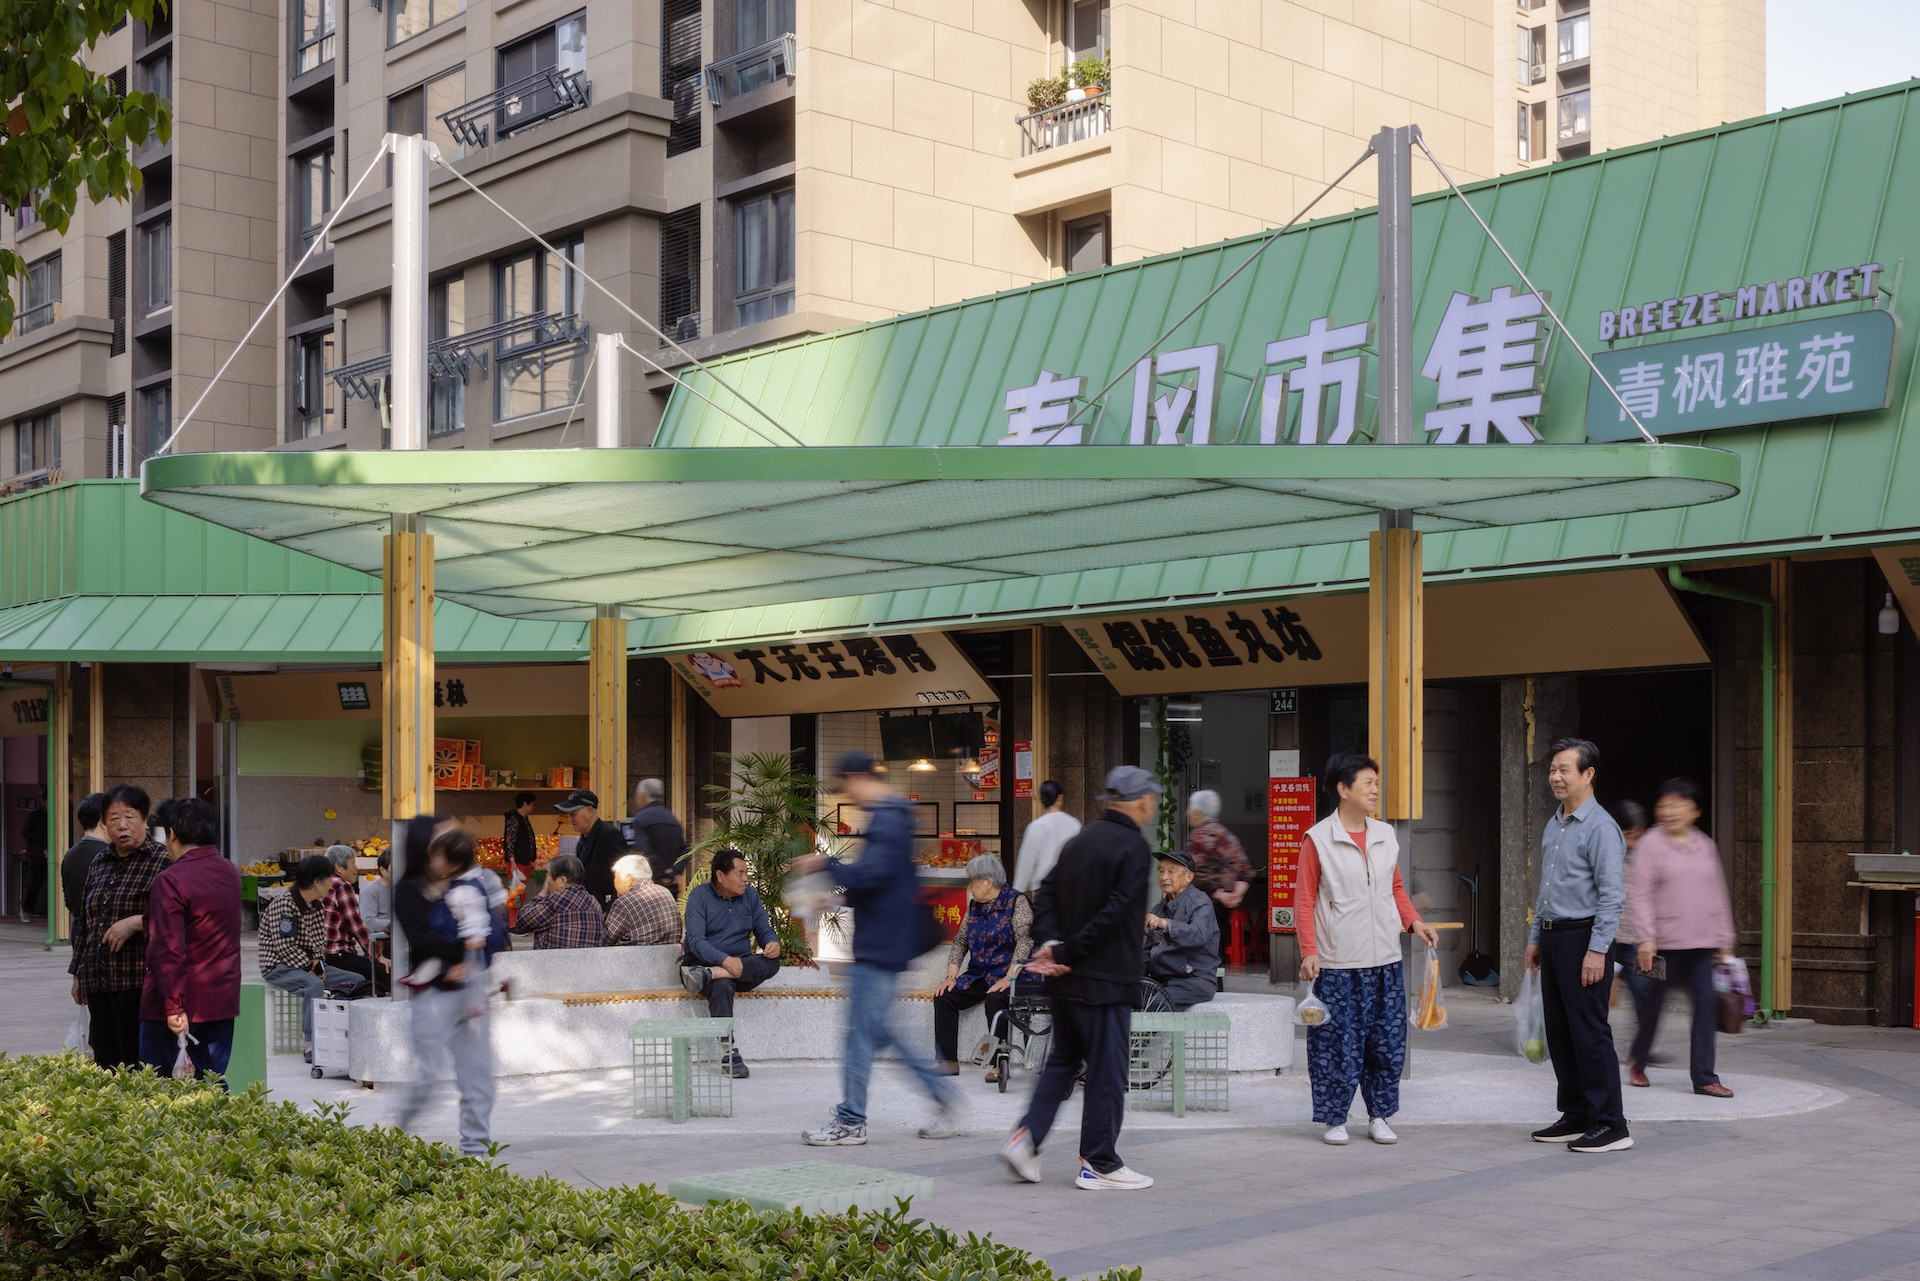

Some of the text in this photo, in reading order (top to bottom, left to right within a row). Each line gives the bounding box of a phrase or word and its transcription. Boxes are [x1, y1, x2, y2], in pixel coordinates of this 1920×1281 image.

[1599, 263, 1880, 341] BREEZE MARKET
[1615, 331, 1855, 422] 青枫雅苑
[1102, 606, 1323, 671] 馄饨鱼丸坊
[1274, 699, 1293, 711] 244
[933, 904, 962, 925] 烤鸭
